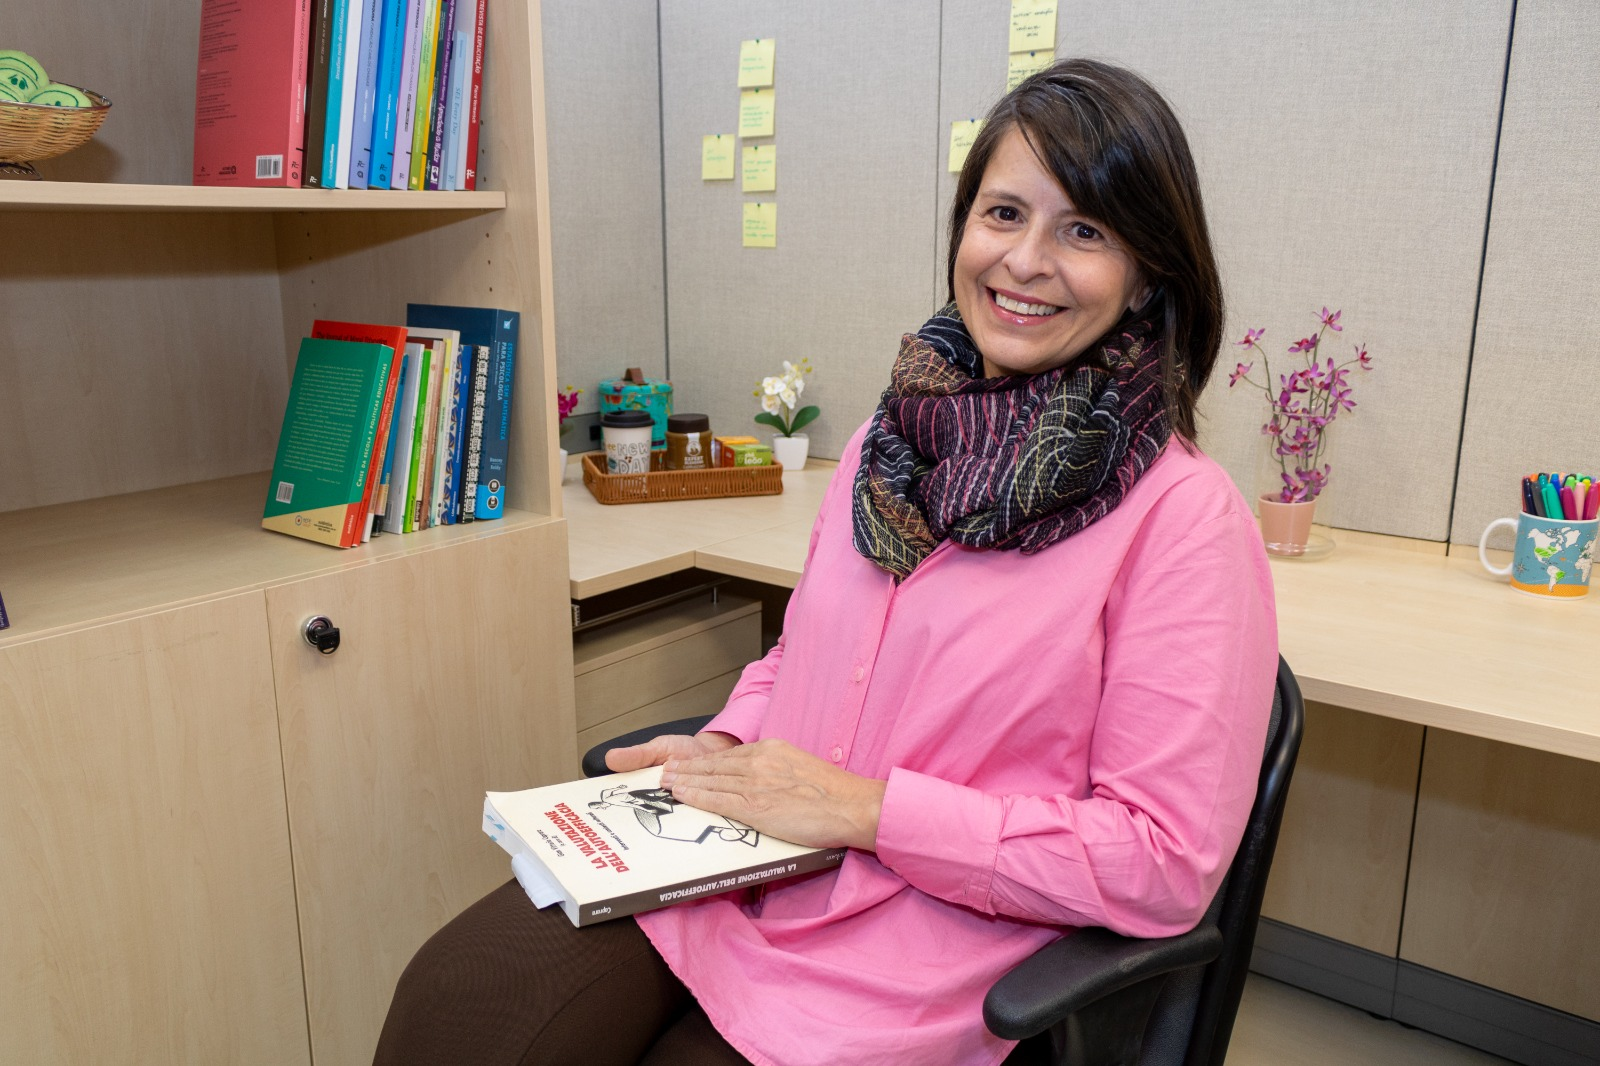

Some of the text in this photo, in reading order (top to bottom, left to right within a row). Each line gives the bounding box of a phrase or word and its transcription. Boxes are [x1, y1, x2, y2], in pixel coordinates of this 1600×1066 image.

[474, 35, 482, 74] EXPLICITAÇÃO
[436, 103, 444, 134] Aprendendo
[504, 343, 513, 382] ESTATÍSTICA
[497, 361, 505, 400] PSICOLOGIA
[356, 470, 364, 487] CRISE
[363, 437, 371, 458] ESCOLA
[369, 400, 379, 428] POLÍTICAS
[376, 363, 388, 398] EDUCATIVAS
[500, 400, 509, 440] MATEMÁTICA
[744, 456, 762, 464] leão
[586, 812, 602, 823] culturali
[597, 822, 613, 833] contesti
[536, 829, 550, 840] Caprara
[544, 810, 608, 869] LA VALUTAZIONE
[545, 840, 558, 850] Vittorio
[554, 803, 630, 873] DELL'AUTOEFFICACIA
[610, 835, 629, 851] Interventi
[737, 865, 786, 884] VALUTAZIONE
[787, 863, 797, 872] LA
[659, 877, 736, 902] DELL'AUTOEFFICACIA
[591, 906, 612, 916] Caprara
